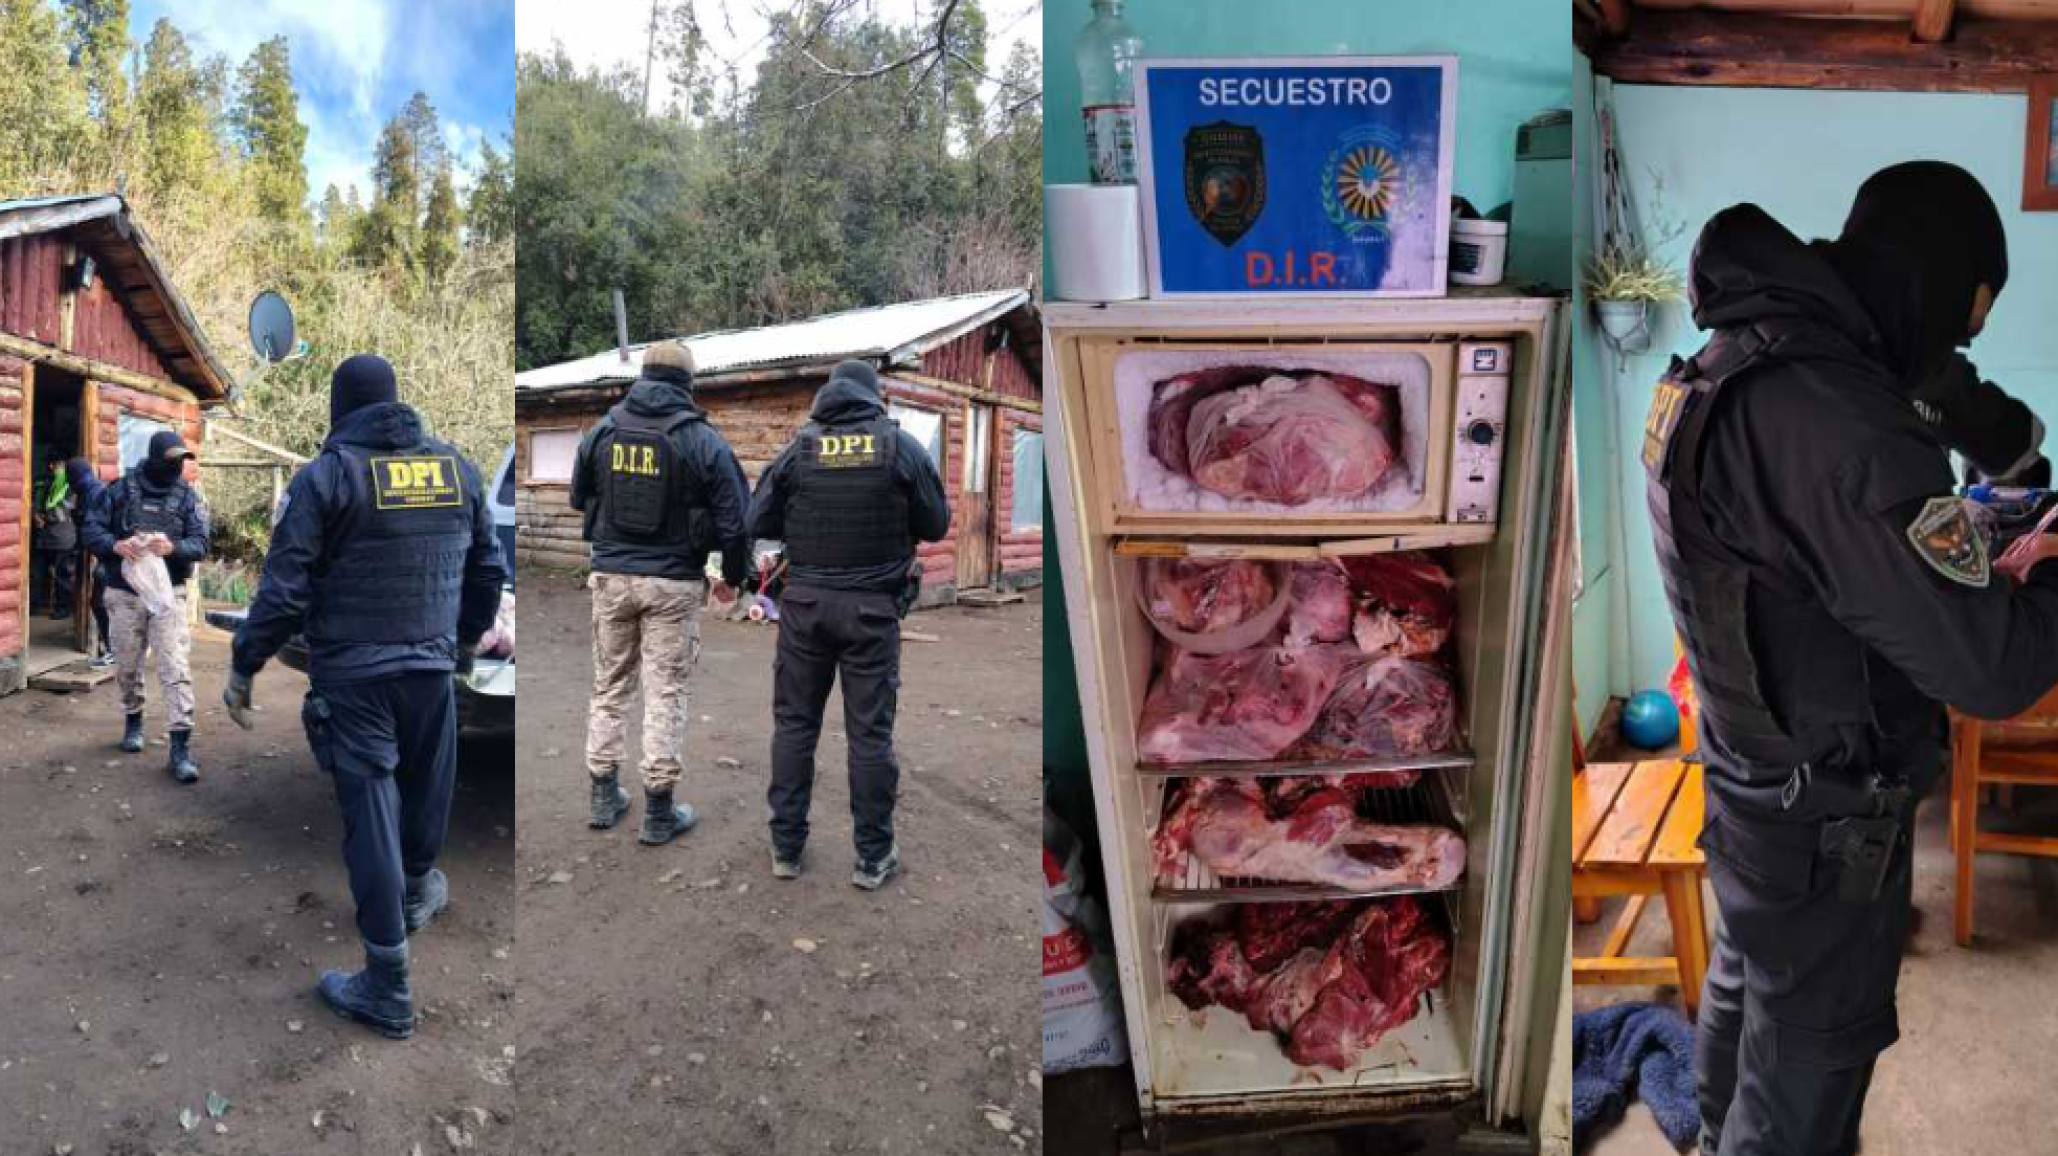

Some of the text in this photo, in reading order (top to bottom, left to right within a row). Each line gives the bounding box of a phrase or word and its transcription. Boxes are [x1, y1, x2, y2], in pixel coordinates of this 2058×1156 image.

[1199, 77, 1392, 106] SECUESTRO
[819, 434, 875, 455] DPI
[612, 443, 660, 475] D.I.R.
[387, 461, 444, 488] DPI
